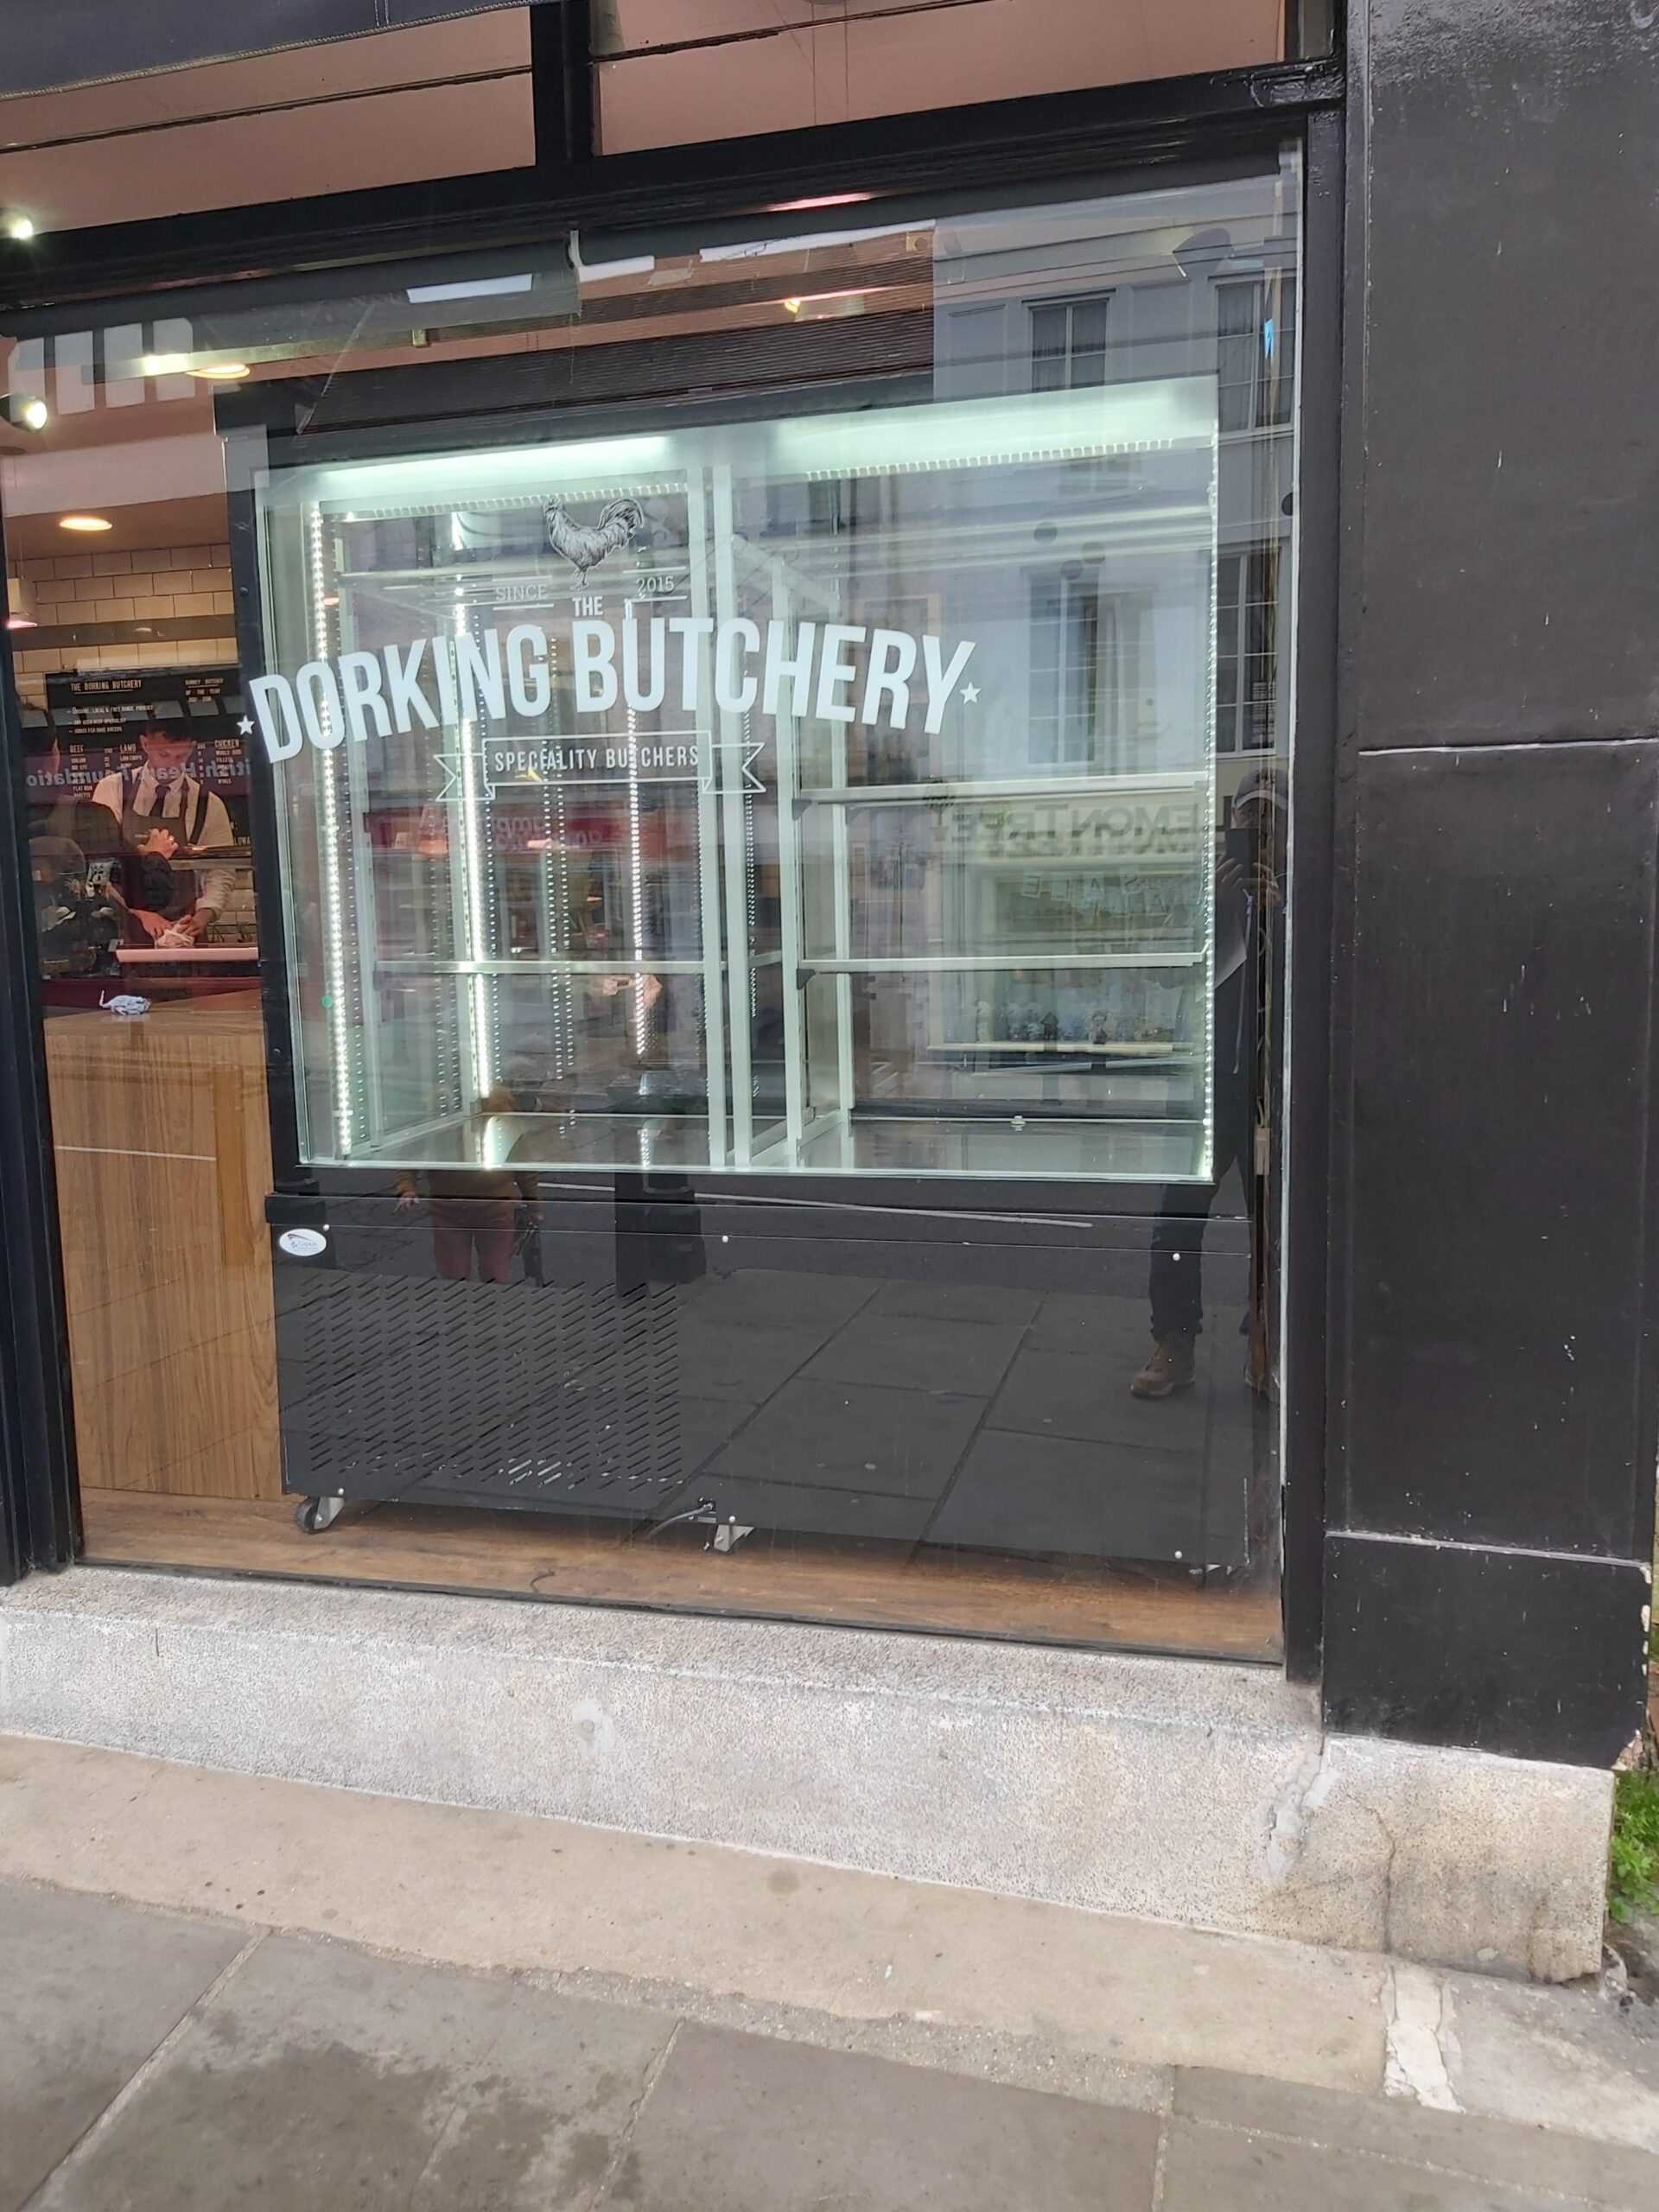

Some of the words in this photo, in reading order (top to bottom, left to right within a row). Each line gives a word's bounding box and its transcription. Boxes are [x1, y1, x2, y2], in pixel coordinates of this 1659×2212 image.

[496, 584, 549, 601] SINCE
[635, 575, 675, 594] 2015
[571, 595, 604, 617] THE
[71, 683, 81, 691] THE
[84, 681, 110, 690] DORKING
[112, 679, 142, 689] BUTCHERY
[248, 624, 552, 764] DORKING
[570, 616, 977, 735] BUTCHERY
[69, 744, 84, 753] BEEF
[120, 743, 137, 753] LAMB
[214, 738, 240, 748] CHICKEN
[494, 748, 598, 772] SPECIALITY
[605, 745, 699, 772] BUTCHERS
